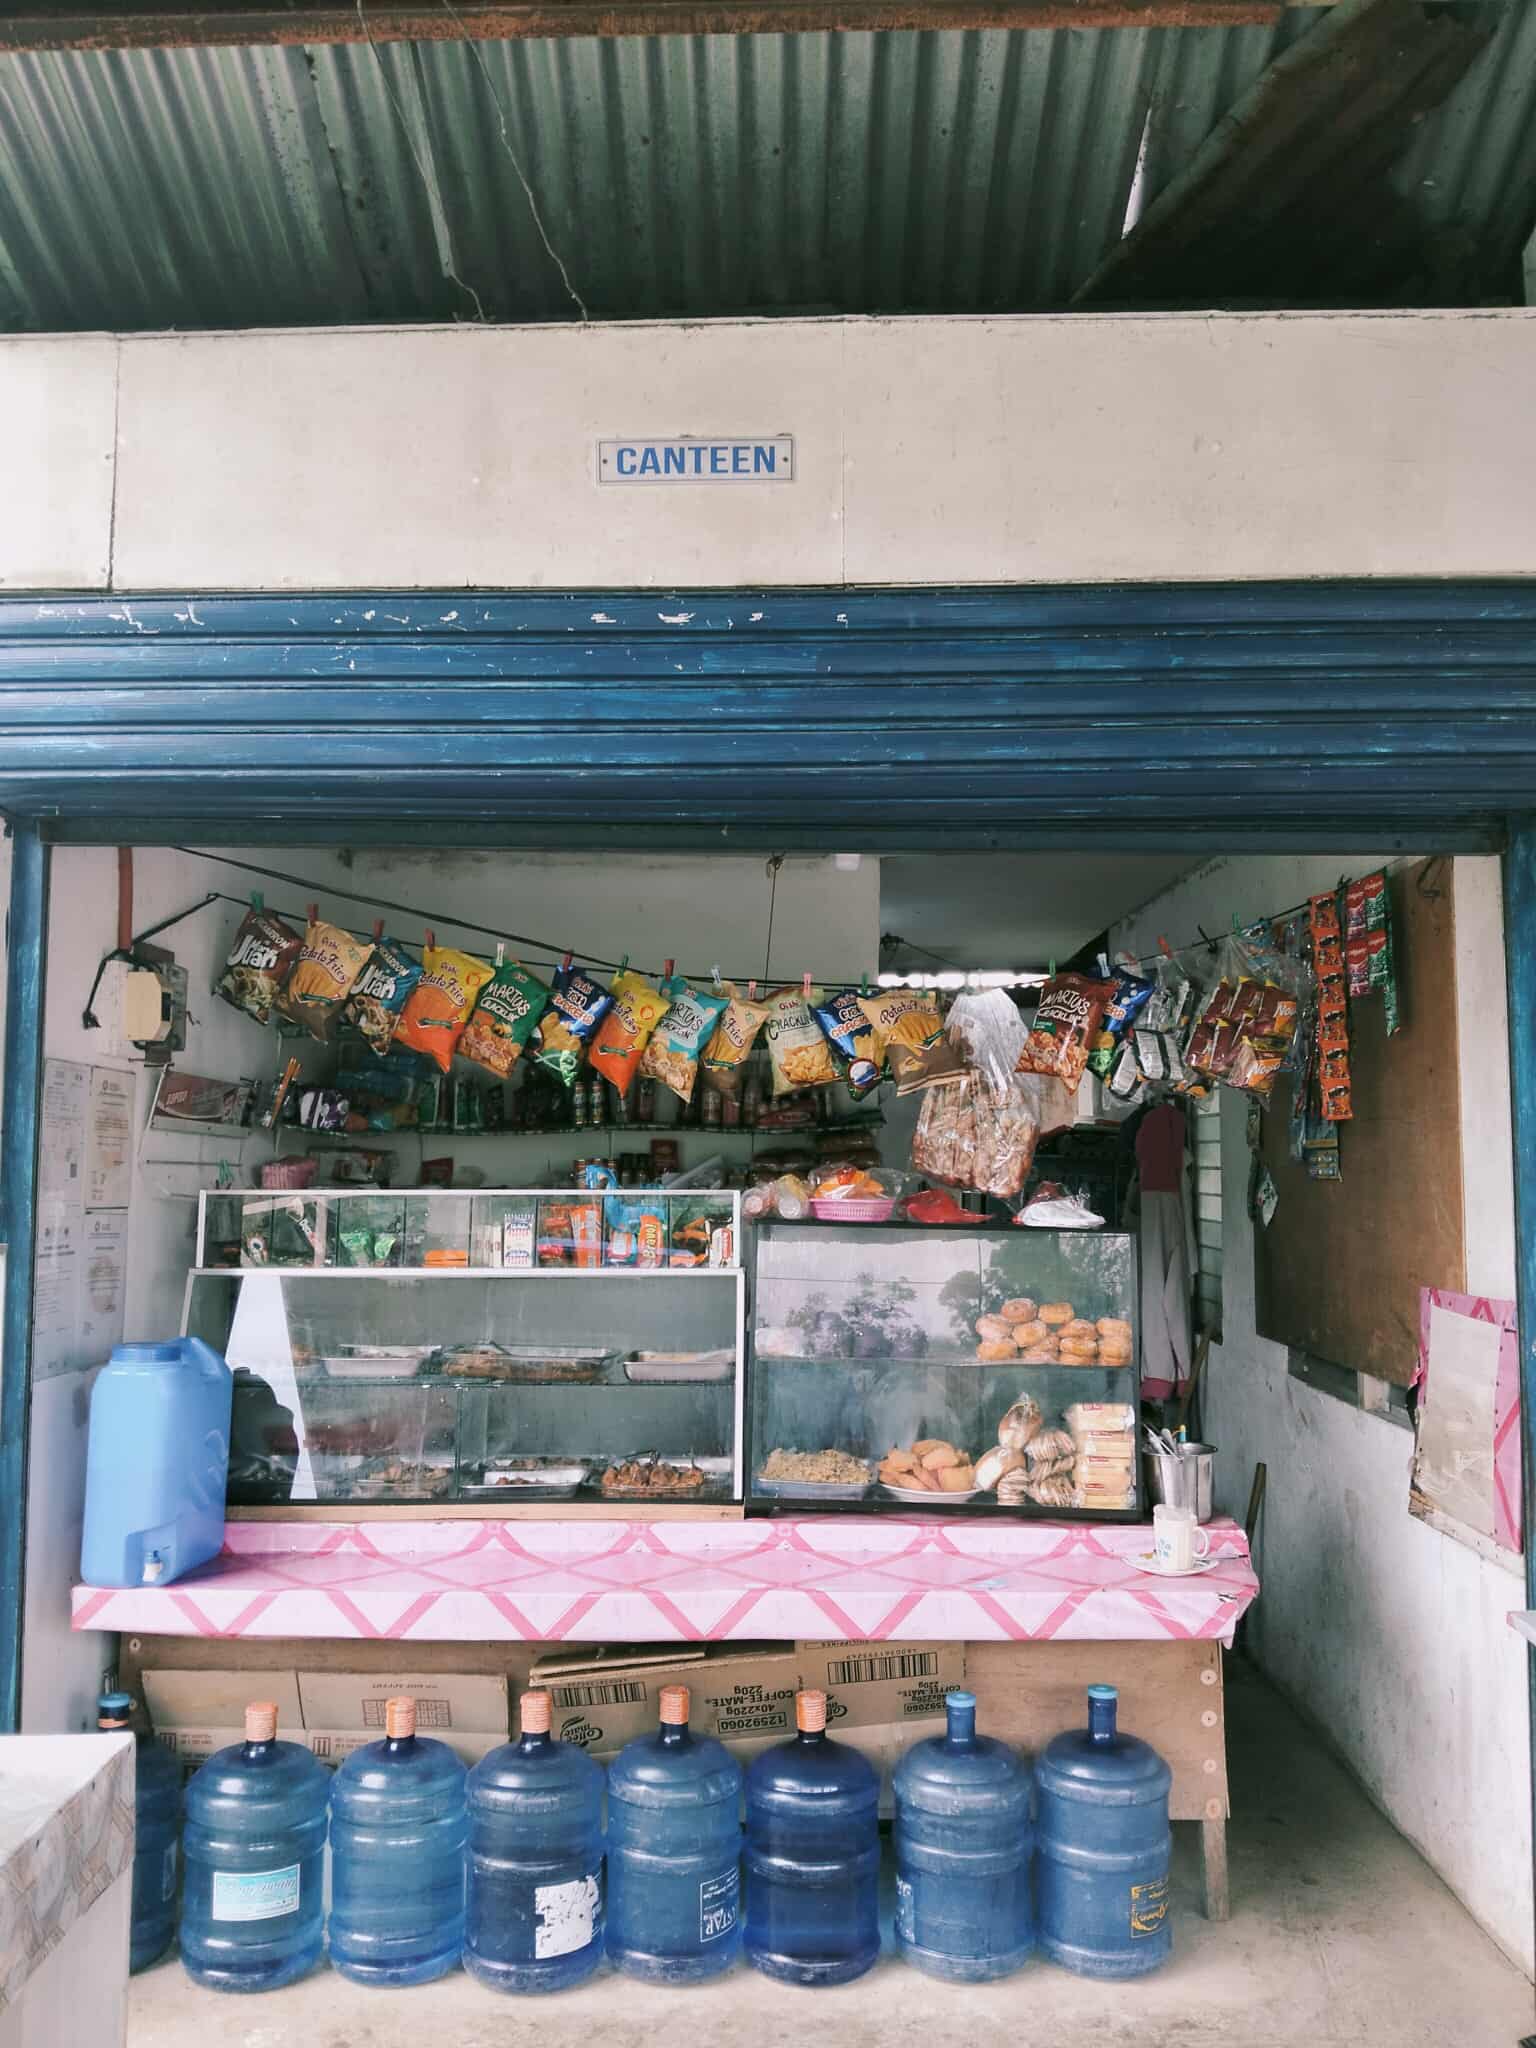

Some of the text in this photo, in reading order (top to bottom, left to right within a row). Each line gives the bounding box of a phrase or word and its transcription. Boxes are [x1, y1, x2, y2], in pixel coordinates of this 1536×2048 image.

[617, 445, 776, 475] CANTEEN
[226, 934, 278, 969] Juan
[350, 963, 397, 999] Juan
[668, 1001, 704, 1031] ARTY'S
[1040, 989, 1091, 1015] MARTY'S
[643, 1223, 657, 1260] Bravo!
[734, 1685, 762, 1696] 220g
[720, 1715, 783, 1731] 12592060
[726, 1704, 775, 1716] 40x220g
